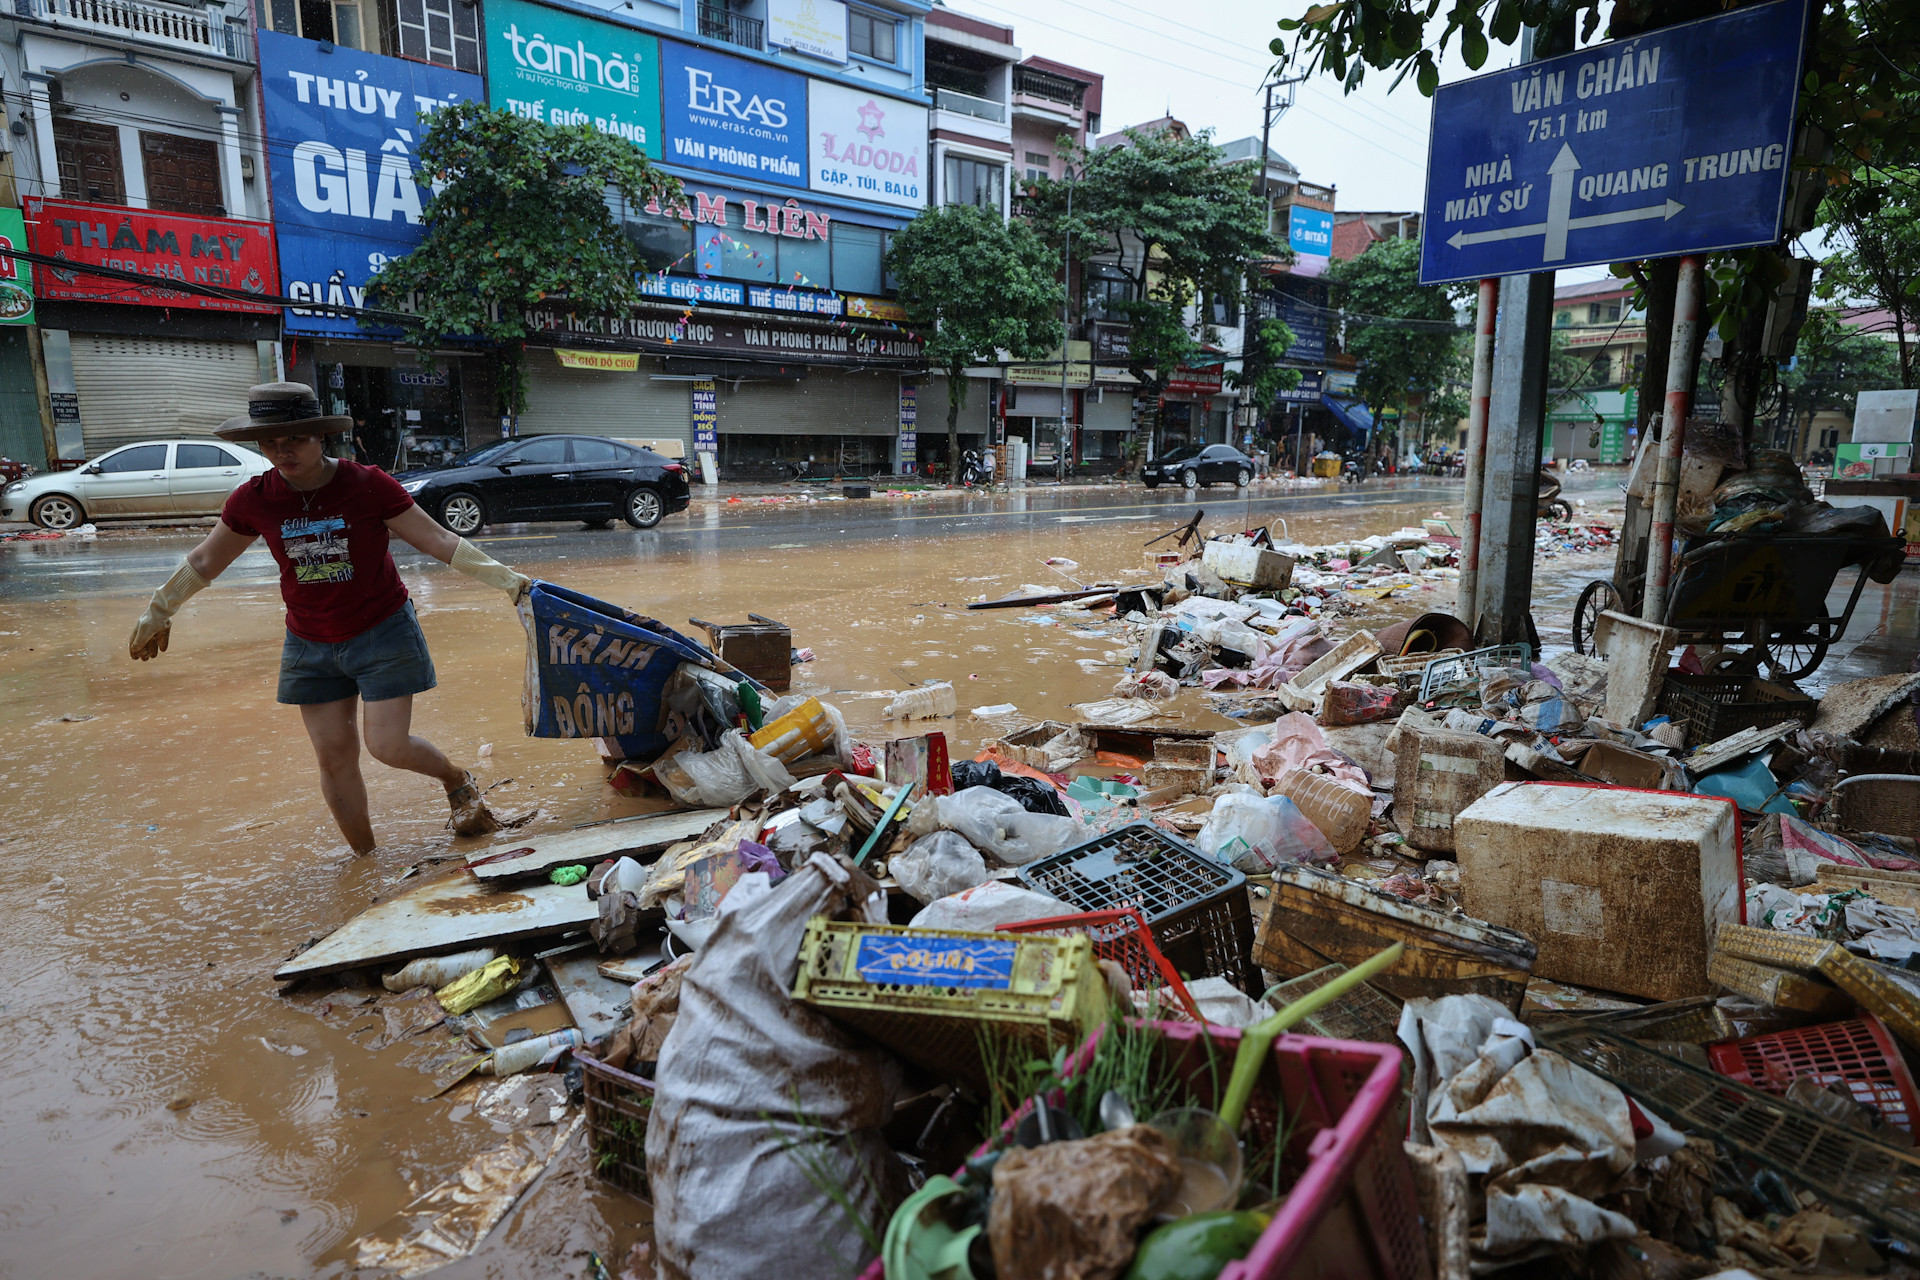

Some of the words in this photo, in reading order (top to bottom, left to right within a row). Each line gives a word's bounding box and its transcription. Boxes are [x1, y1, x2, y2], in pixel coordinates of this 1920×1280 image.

[536, 73, 555, 87] học
[556, 79, 574, 91] trọn
[574, 82, 590, 94] đời
[631, 63, 640, 93] EDU
[1511, 68, 1565, 114] VĂN
[1576, 38, 1661, 100] CHẤN
[288, 69, 402, 119] THỦY
[684, 65, 789, 129] ERAS
[506, 98, 545, 123] THẾ
[550, 107, 590, 127] GIỚI
[594, 113, 647, 144] BẢNG
[688, 112, 789, 144] www.eras.com.vn
[1528, 116, 1566, 143] 75.1
[1577, 108, 1608, 133] km
[674, 137, 706, 158] VĂN
[708, 145, 759, 169] PHÒNG
[760, 154, 801, 178] PHẨM
[1465, 154, 1513, 189] NHÀ
[1579, 163, 1669, 201] QUANG
[1683, 143, 1784, 184] TRUNG
[743, 198, 831, 242] LIÊN
[1444, 190, 1491, 223] MÁY
[1498, 184, 1533, 213] SỨ
[54, 217, 181, 256] THẨM
[190, 232, 246, 262] MỸ
[1304, 230, 1328, 244] BITA'S
[152, 260, 187, 281] HÀ
[193, 264, 231, 286] NỘI
[641, 276, 667, 296] THẾ
[671, 280, 701, 299] GIỚI
[703, 284, 740, 303] SÁCH
[750, 287, 773, 308] THẾ
[774, 290, 797, 310] GIỚI
[799, 292, 815, 312] ĐỒ
[816, 298, 842, 315] CHƠI
[687, 325, 714, 345] HỌC
[880, 340, 920, 357] LADODA
[615, 357, 636, 369] CHƠI
[693, 392, 714, 401] MÁY
[694, 401, 716, 410] TÍNH
[549, 624, 662, 670] HÀNH
